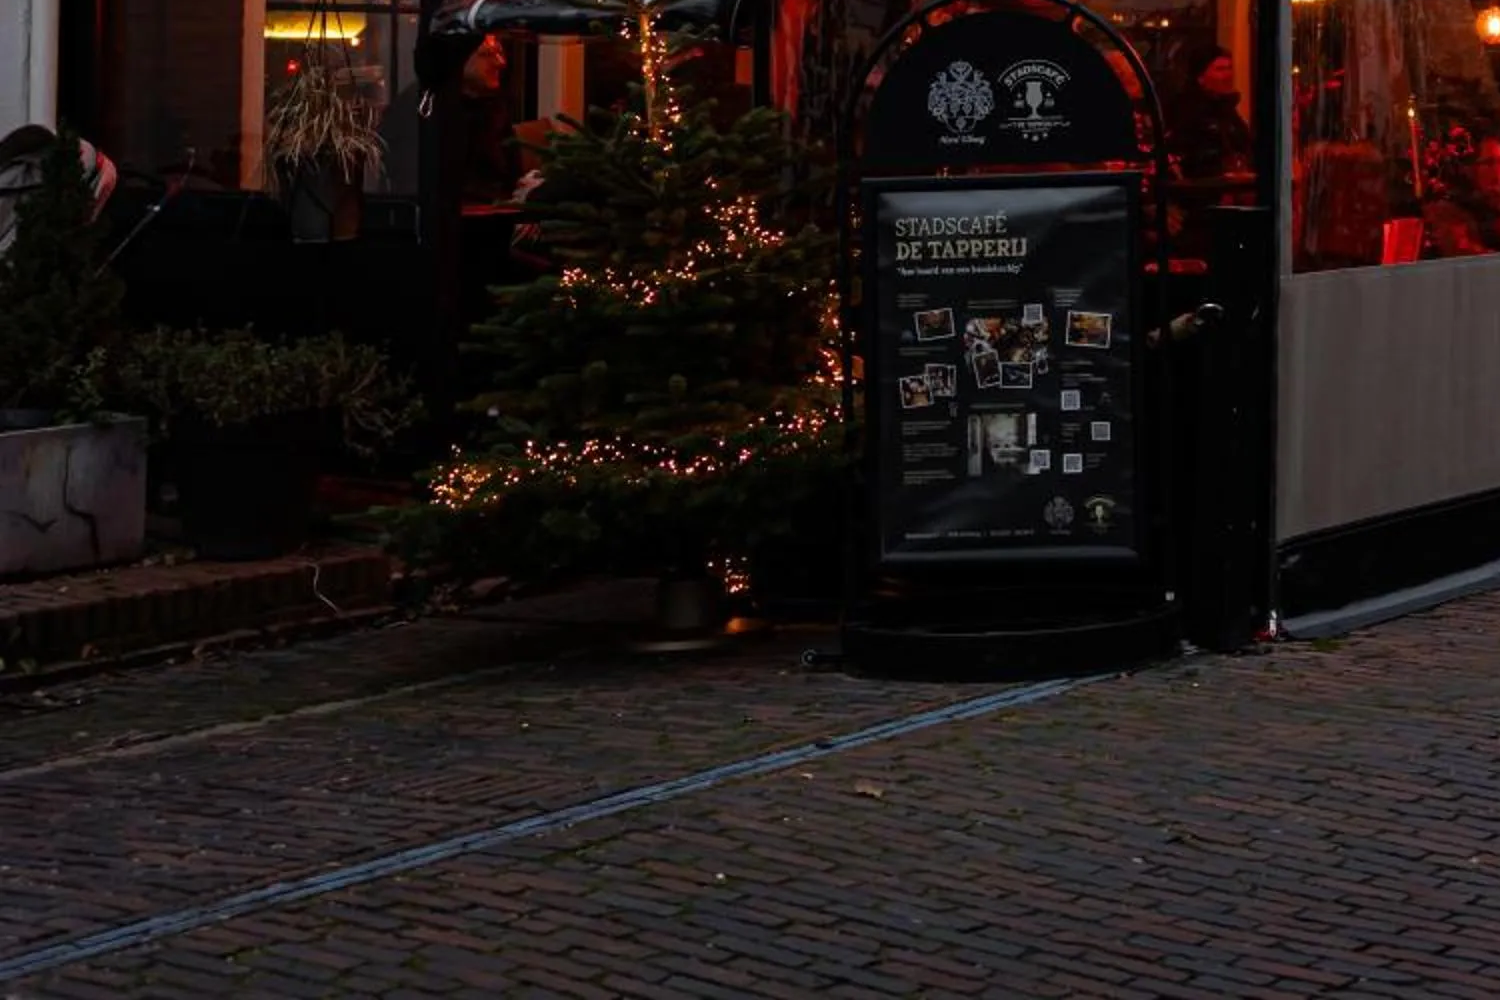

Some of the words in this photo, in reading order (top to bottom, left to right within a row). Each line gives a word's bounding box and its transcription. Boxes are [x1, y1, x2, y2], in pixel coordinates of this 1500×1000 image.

[895, 209, 1008, 237] STADSCAFÉ
[896, 241, 923, 261] DE
[928, 237, 1027, 260] TAPPERIJ
